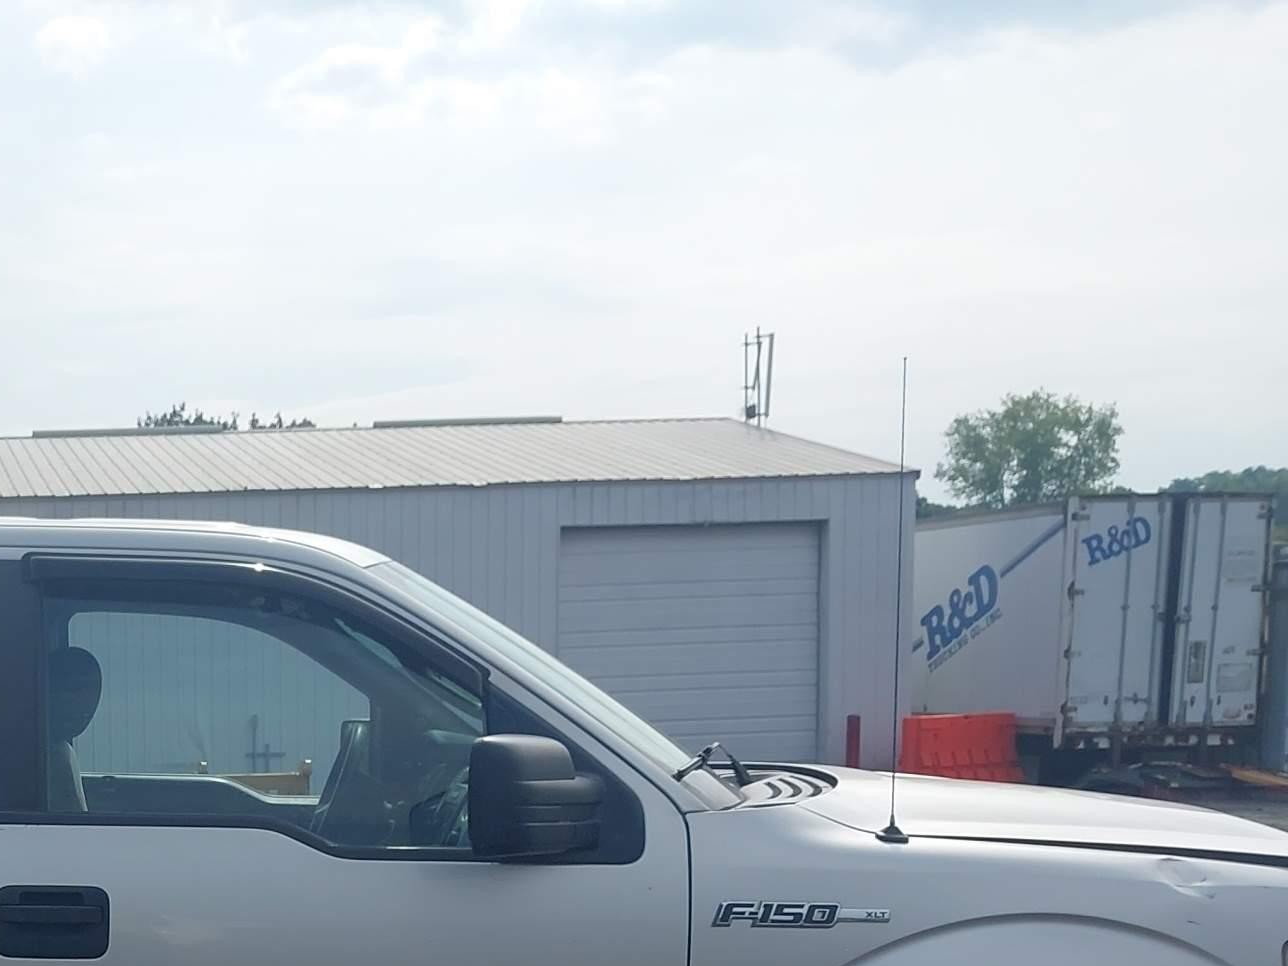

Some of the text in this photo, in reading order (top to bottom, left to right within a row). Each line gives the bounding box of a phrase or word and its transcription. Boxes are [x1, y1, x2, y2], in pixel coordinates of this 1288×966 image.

[1081, 516, 1151, 567] R&D
[920, 564, 998, 661] R&D
[711, 901, 889, 928] F-150 XLT
